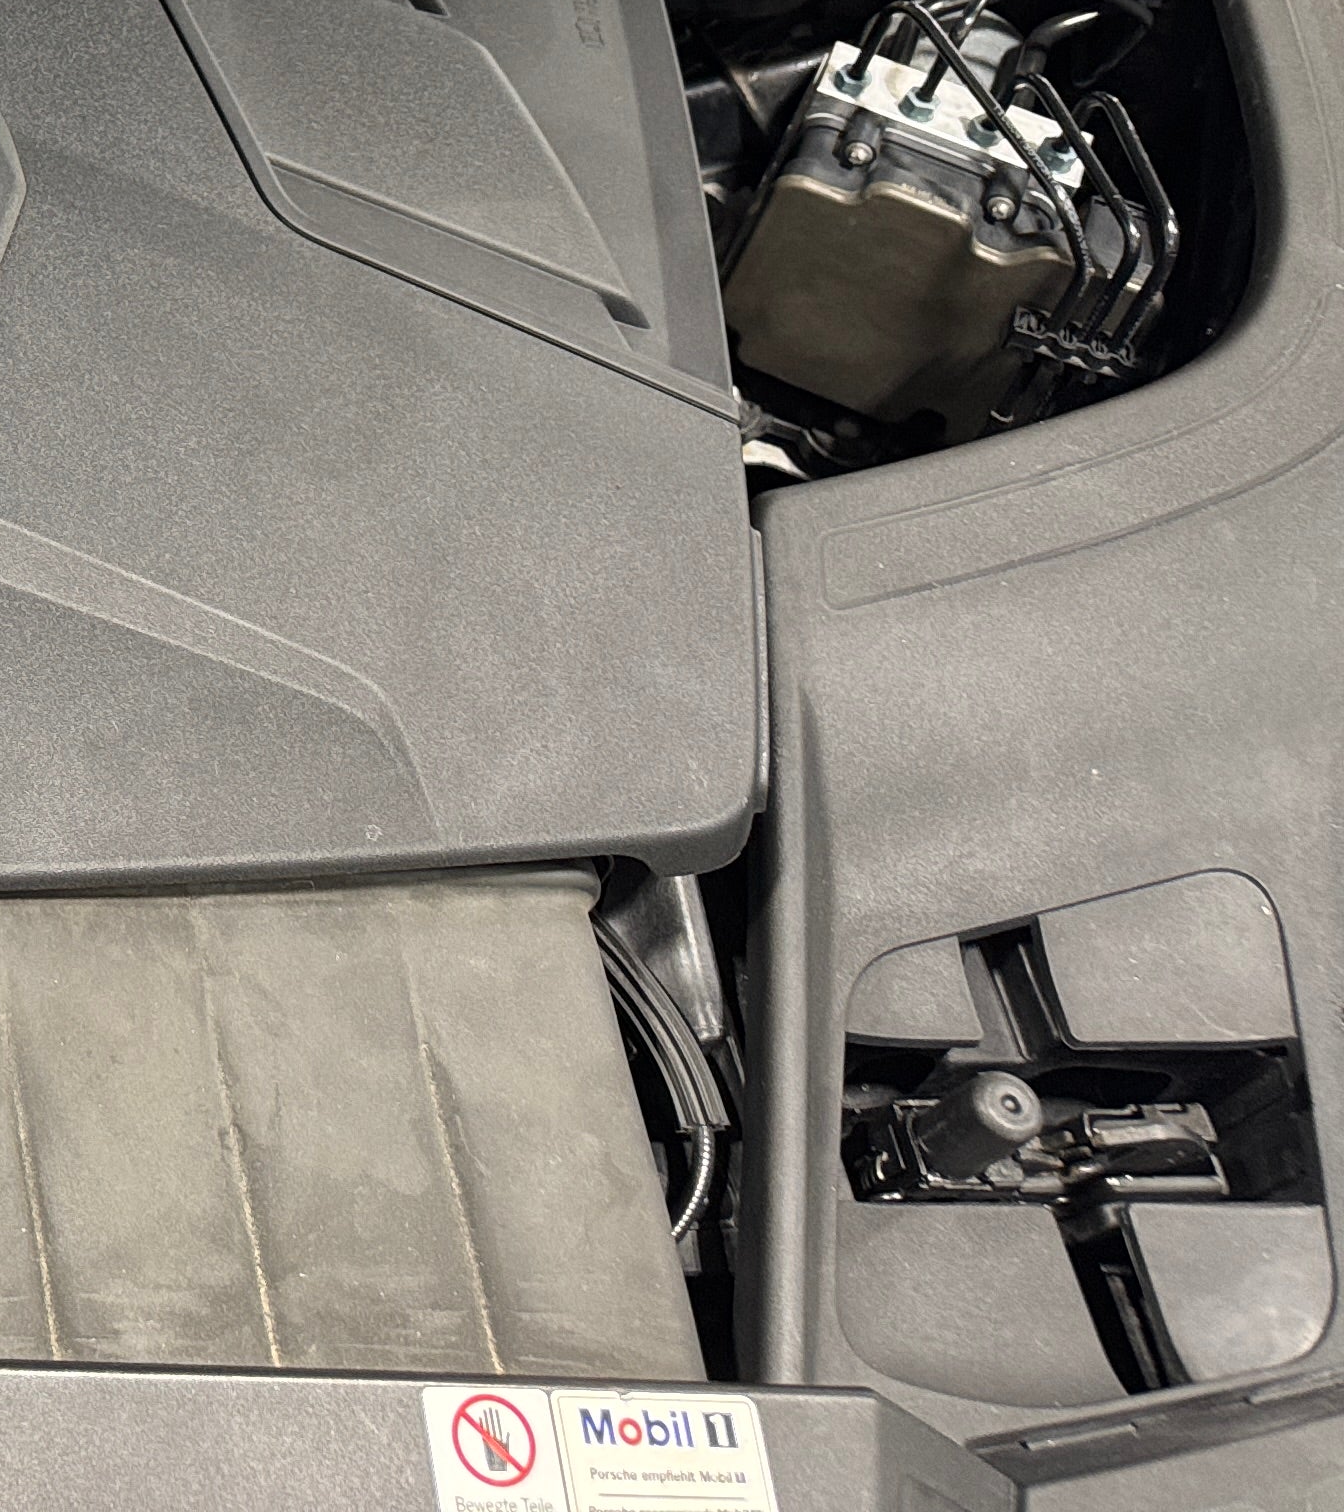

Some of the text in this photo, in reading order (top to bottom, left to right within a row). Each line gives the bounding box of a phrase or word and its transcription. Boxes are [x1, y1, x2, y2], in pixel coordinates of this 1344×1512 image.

[579, 1408, 695, 1448] Mobil
[589, 1466, 638, 1481] Porsche
[699, 1470, 732, 1483] Mobil
[455, 1495, 553, 1512] Bewegte Teile
